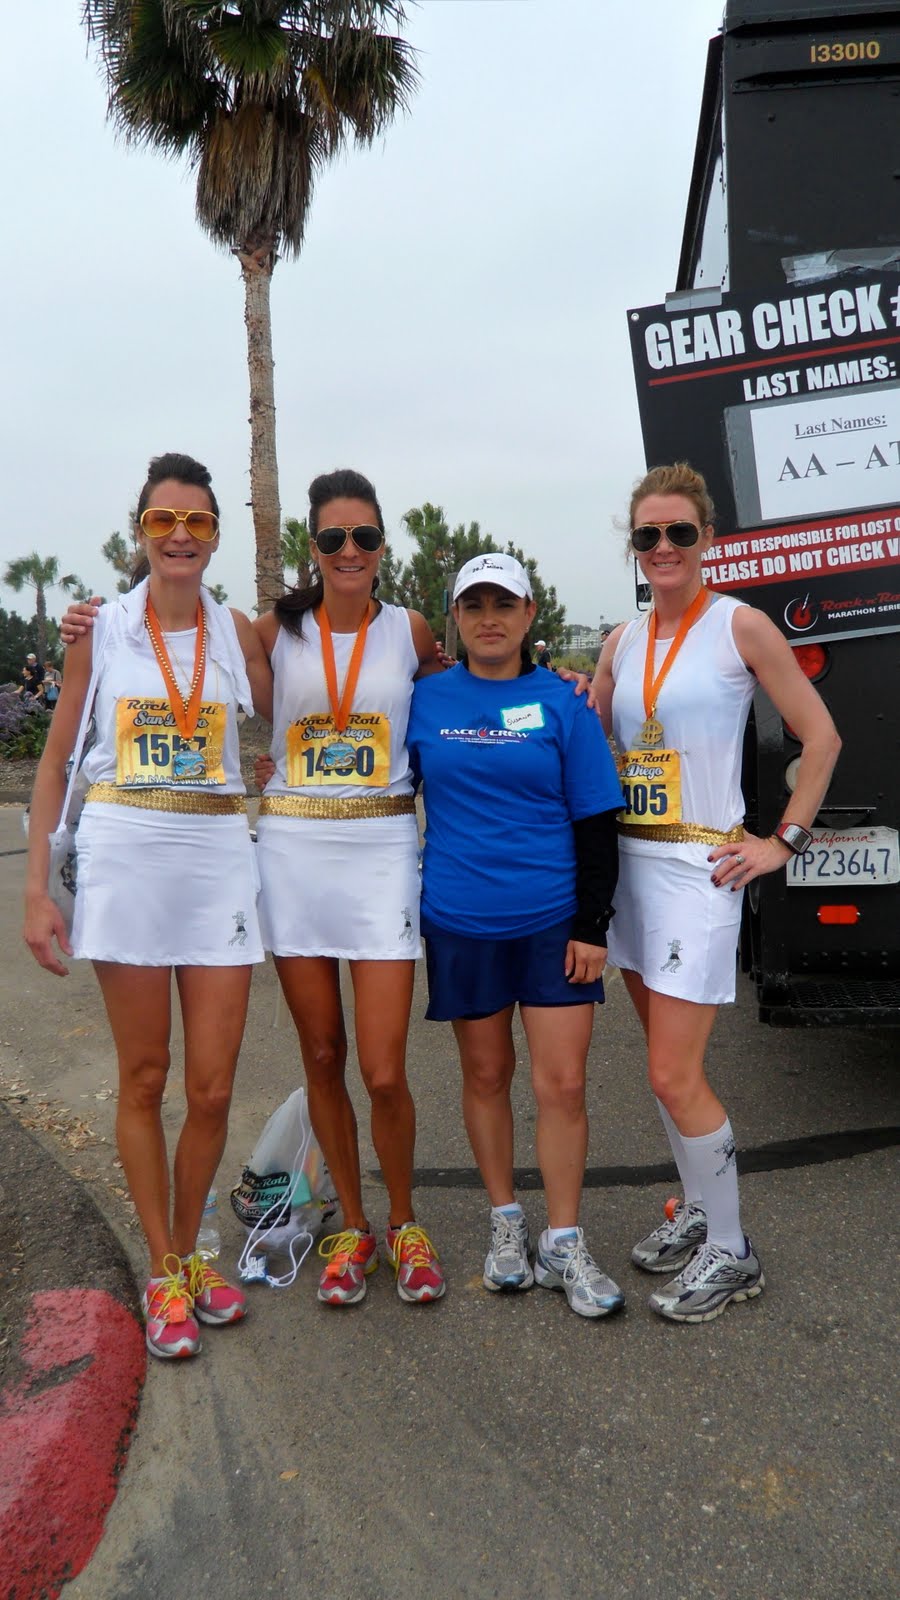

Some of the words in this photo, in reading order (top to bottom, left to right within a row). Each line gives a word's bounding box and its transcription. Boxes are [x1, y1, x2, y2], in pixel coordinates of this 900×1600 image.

[810, 41, 880, 63] 133010
[645, 310, 745, 370] GEAR
[752, 284, 887, 350] CHECK
[743, 370, 800, 401] LAST
[806, 356, 896, 391] NAMES:
[795, 423, 827, 437] Last
[831, 414, 887, 432] Names:
[777, 453, 828, 481] AA
[701, 545, 723, 561] ARE
[724, 541, 749, 558] NOT
[751, 527, 834, 553] RESPONSIBLE
[835, 524, 860, 541] FOR
[861, 518, 891, 536] LOST
[701, 559, 760, 586] PLEASE
[762, 555, 786, 577] DO
[789, 549, 824, 572] NOT
[826, 540, 885, 567] CHECK
[828, 607, 876, 620] MARATHON
[127, 699, 170, 711] Rock
[133, 711, 164, 727] San
[348, 714, 382, 725] Roll
[301, 725, 330, 741] San
[340, 725, 374, 742] iego
[440, 728, 477, 736] RACE
[489, 729, 530, 739] CREW
[301, 745, 375, 778] 140
[642, 752, 672, 763] Roll
[626, 762, 664, 781] Diego
[811, 831, 876, 848] alifornia
